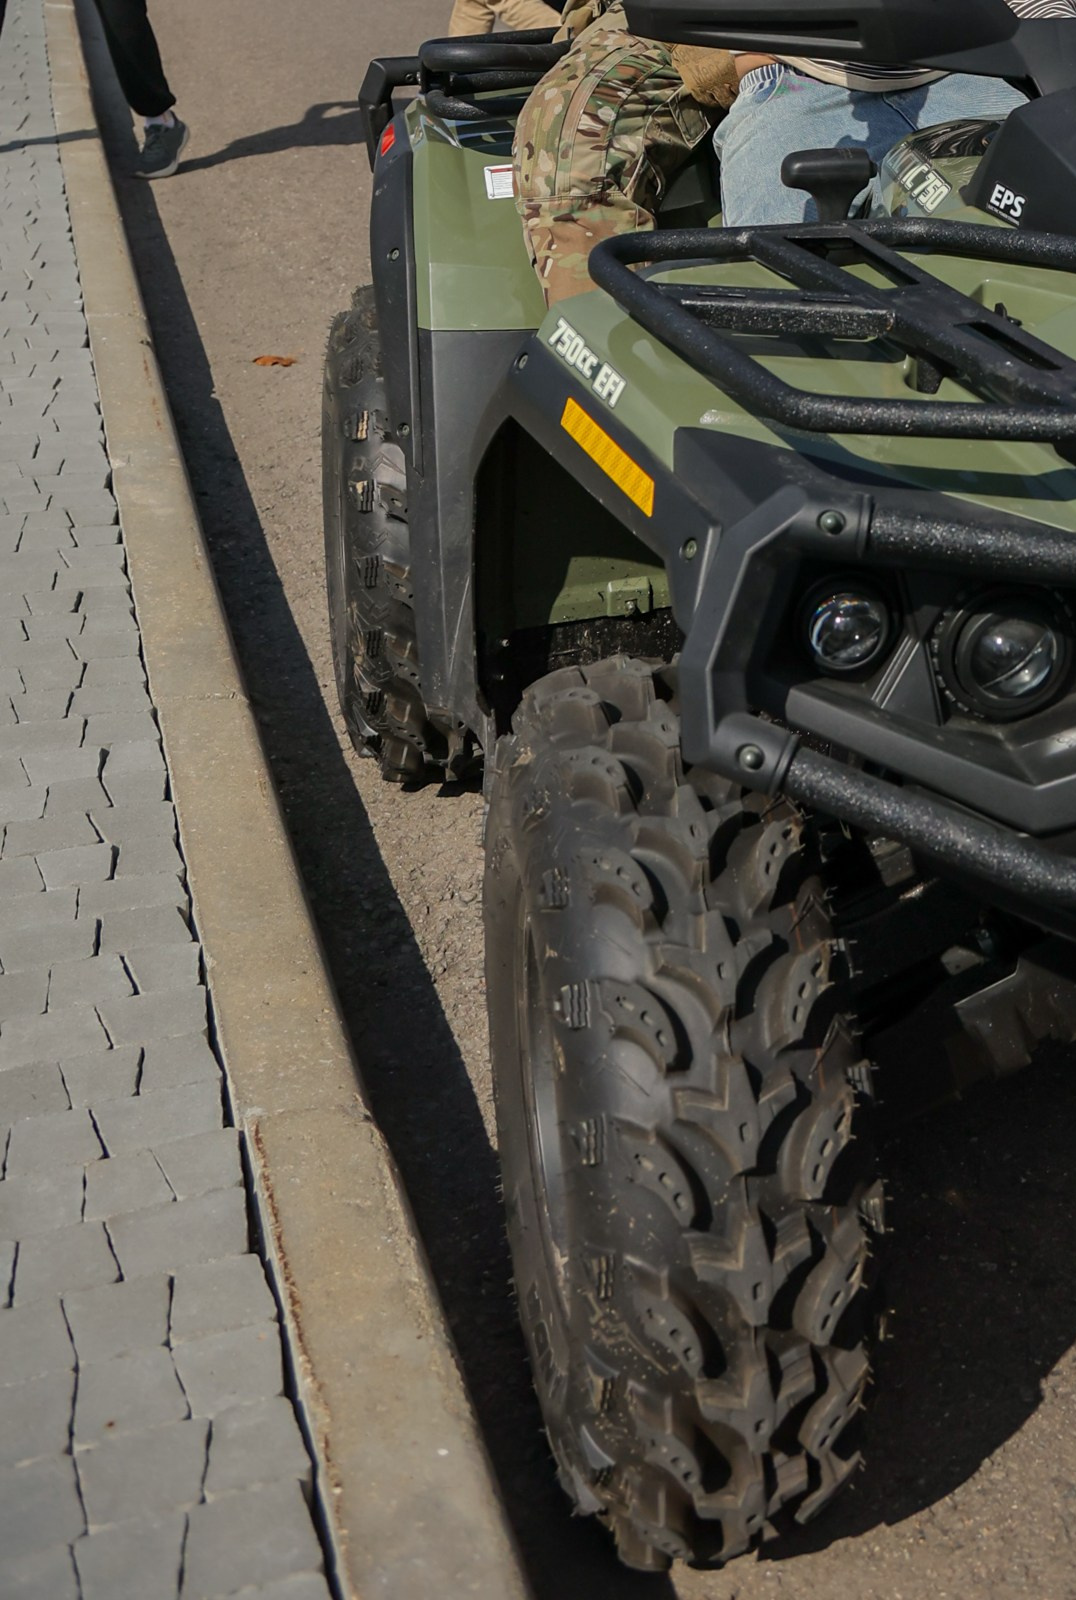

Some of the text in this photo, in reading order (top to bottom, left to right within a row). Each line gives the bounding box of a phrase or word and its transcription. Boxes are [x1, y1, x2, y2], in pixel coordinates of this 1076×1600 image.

[911, 169, 951, 213] 750
[990, 184, 1026, 218] EPS
[548, 317, 627, 409] 750cc EFI
